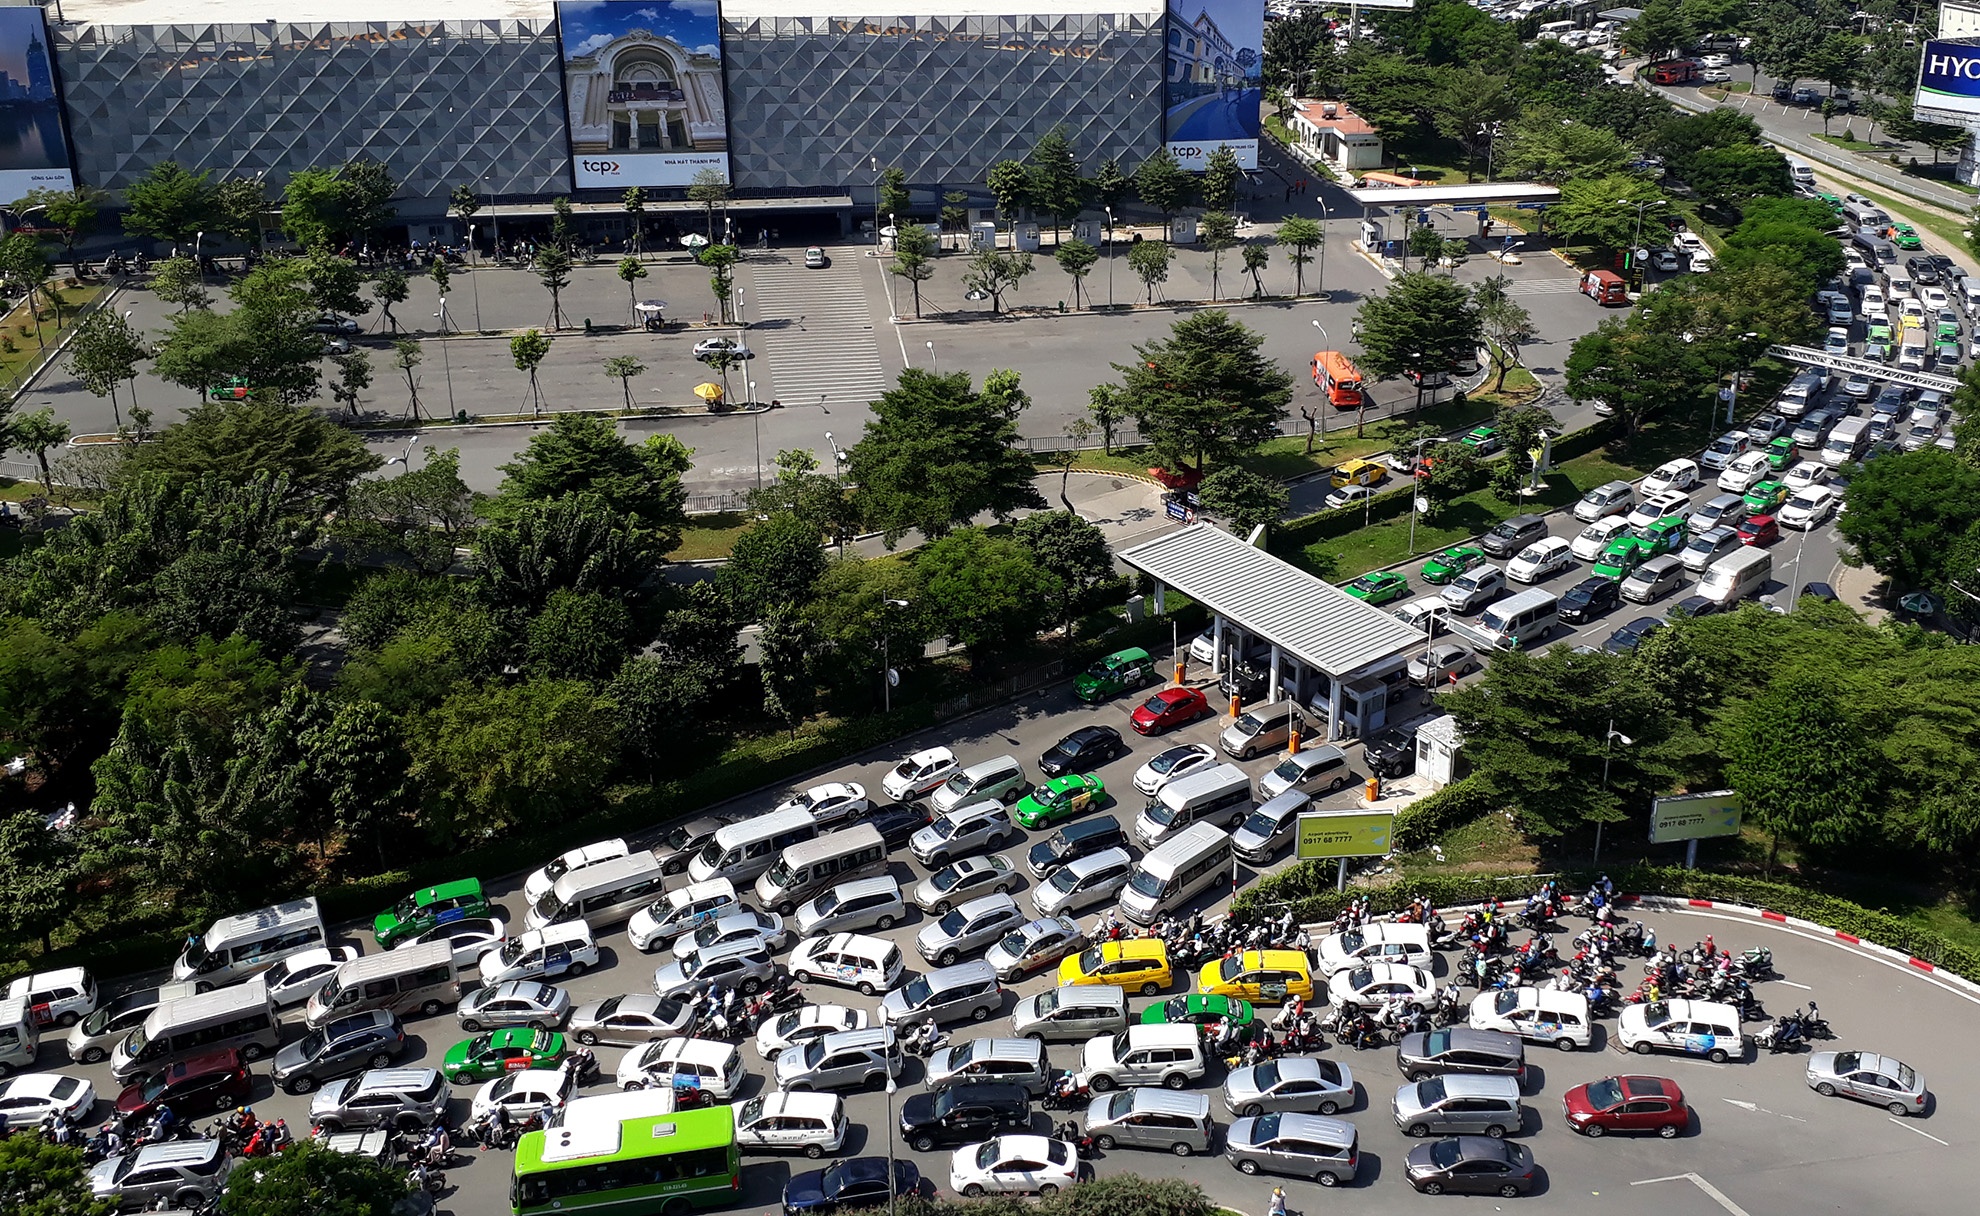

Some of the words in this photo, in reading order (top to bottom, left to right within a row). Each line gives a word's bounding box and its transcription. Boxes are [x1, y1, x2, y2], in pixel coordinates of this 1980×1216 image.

[1172, 146, 1195, 159] tcp
[583, 160, 611, 175] tcp
[1659, 820, 1676, 828] 0917
